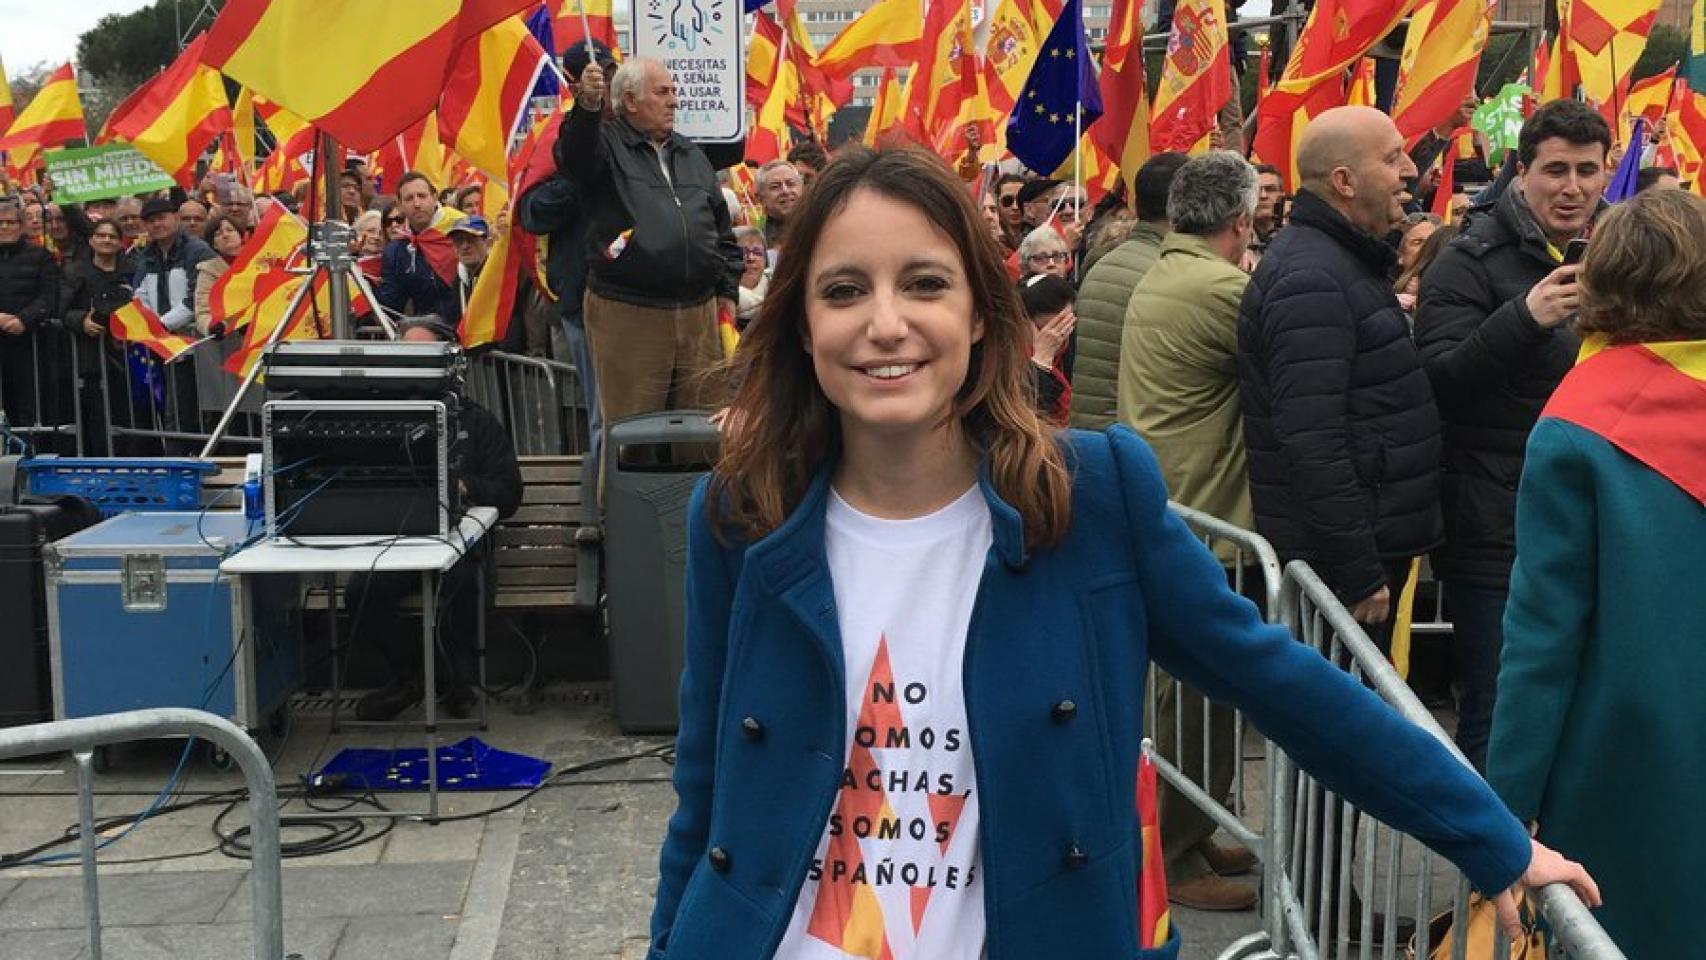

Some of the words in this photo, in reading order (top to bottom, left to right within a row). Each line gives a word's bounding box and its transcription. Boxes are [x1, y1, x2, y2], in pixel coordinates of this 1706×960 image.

[684, 69, 721, 85] SEÑAL
[689, 86, 722, 98] USAR
[50, 168, 89, 187] SIN
[872, 682, 928, 704] NO
[854, 726, 961, 751] OMOS
[839, 767, 973, 799] ACHAS,
[829, 815, 951, 843] SOMOS
[808, 857, 977, 889] SPAÑOLES
